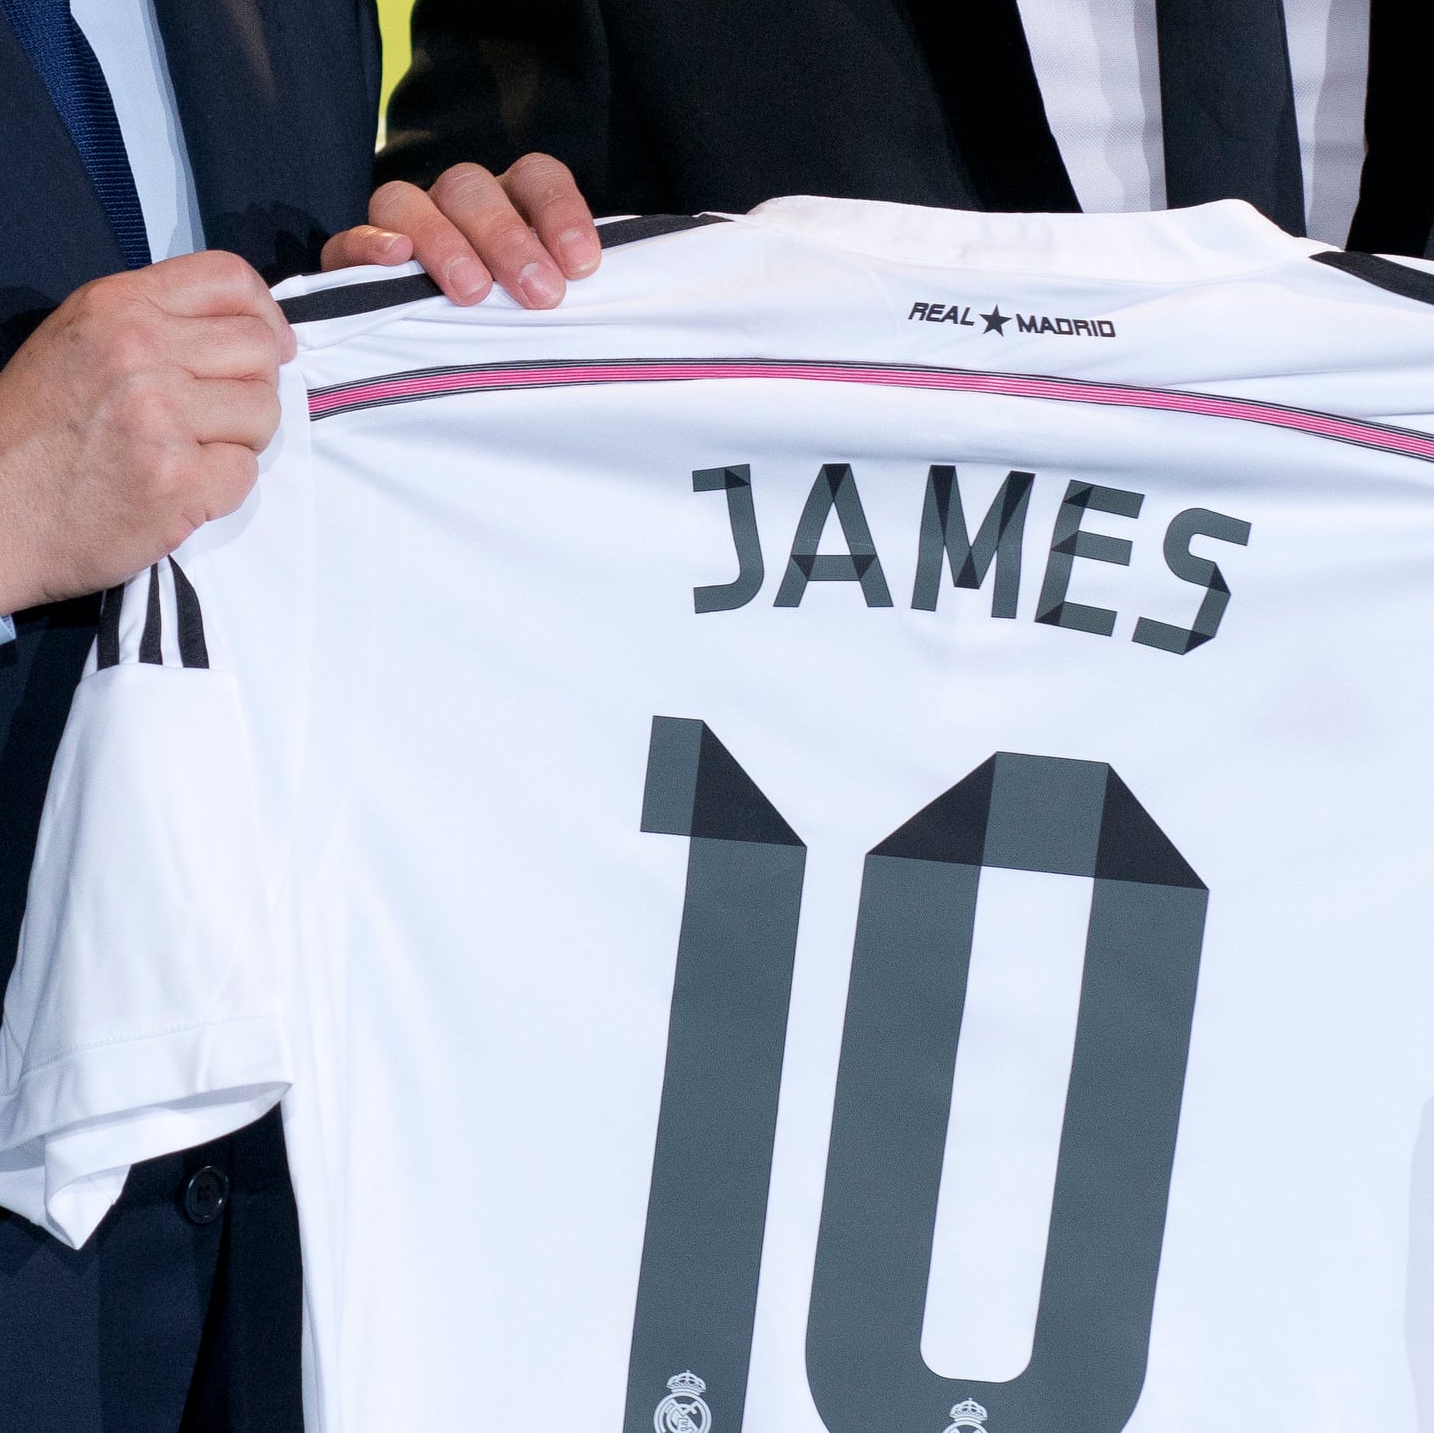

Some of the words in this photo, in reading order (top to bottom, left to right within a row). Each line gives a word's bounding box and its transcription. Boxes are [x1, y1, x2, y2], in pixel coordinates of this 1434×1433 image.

[908, 302, 975, 326] REAL
[1016, 313, 1116, 337] MADRID
[692, 463, 1251, 655] JAMES
[622, 715, 1210, 1433] 10
